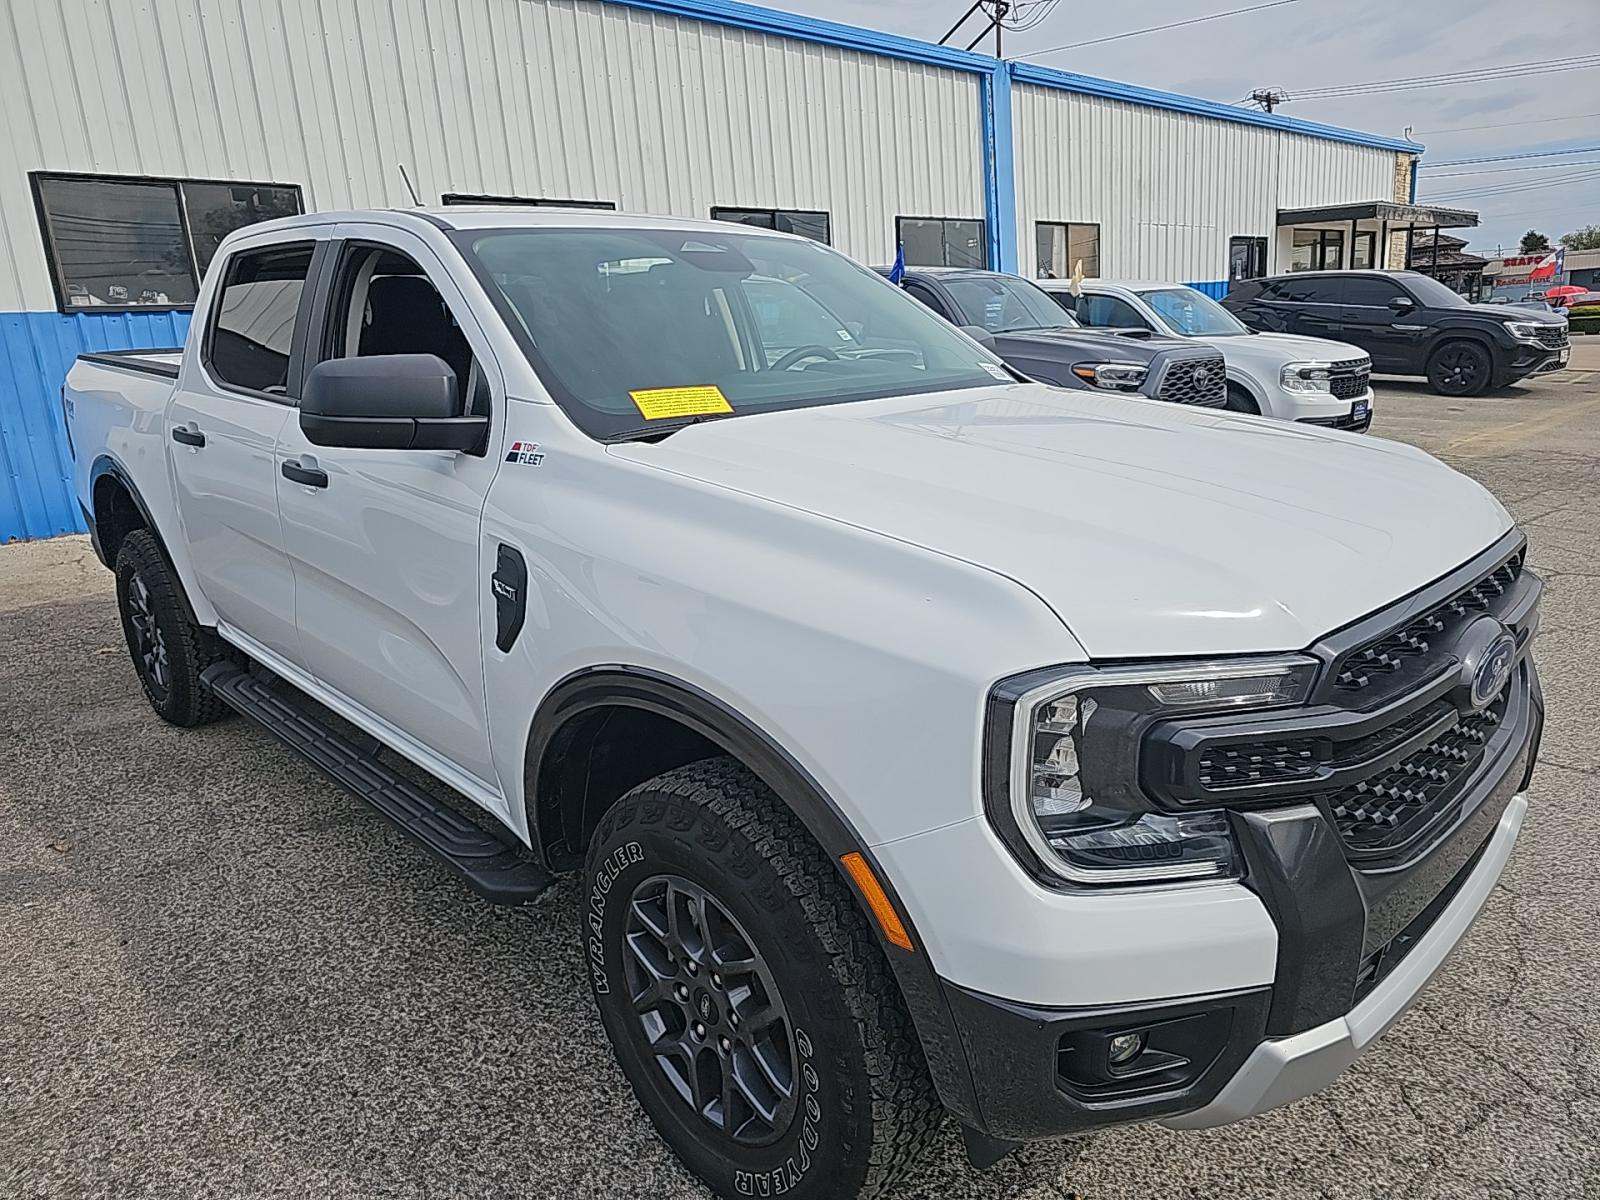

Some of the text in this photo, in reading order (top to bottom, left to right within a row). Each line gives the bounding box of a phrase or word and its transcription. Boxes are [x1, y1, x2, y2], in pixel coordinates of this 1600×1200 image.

[1503, 255, 1545, 267] SEAFO
[523, 442, 540, 453] TDF
[518, 452, 545, 466] FLEET
[588, 841, 645, 994] WRANGLER
[734, 1028, 821, 1197] GOODYEAR
